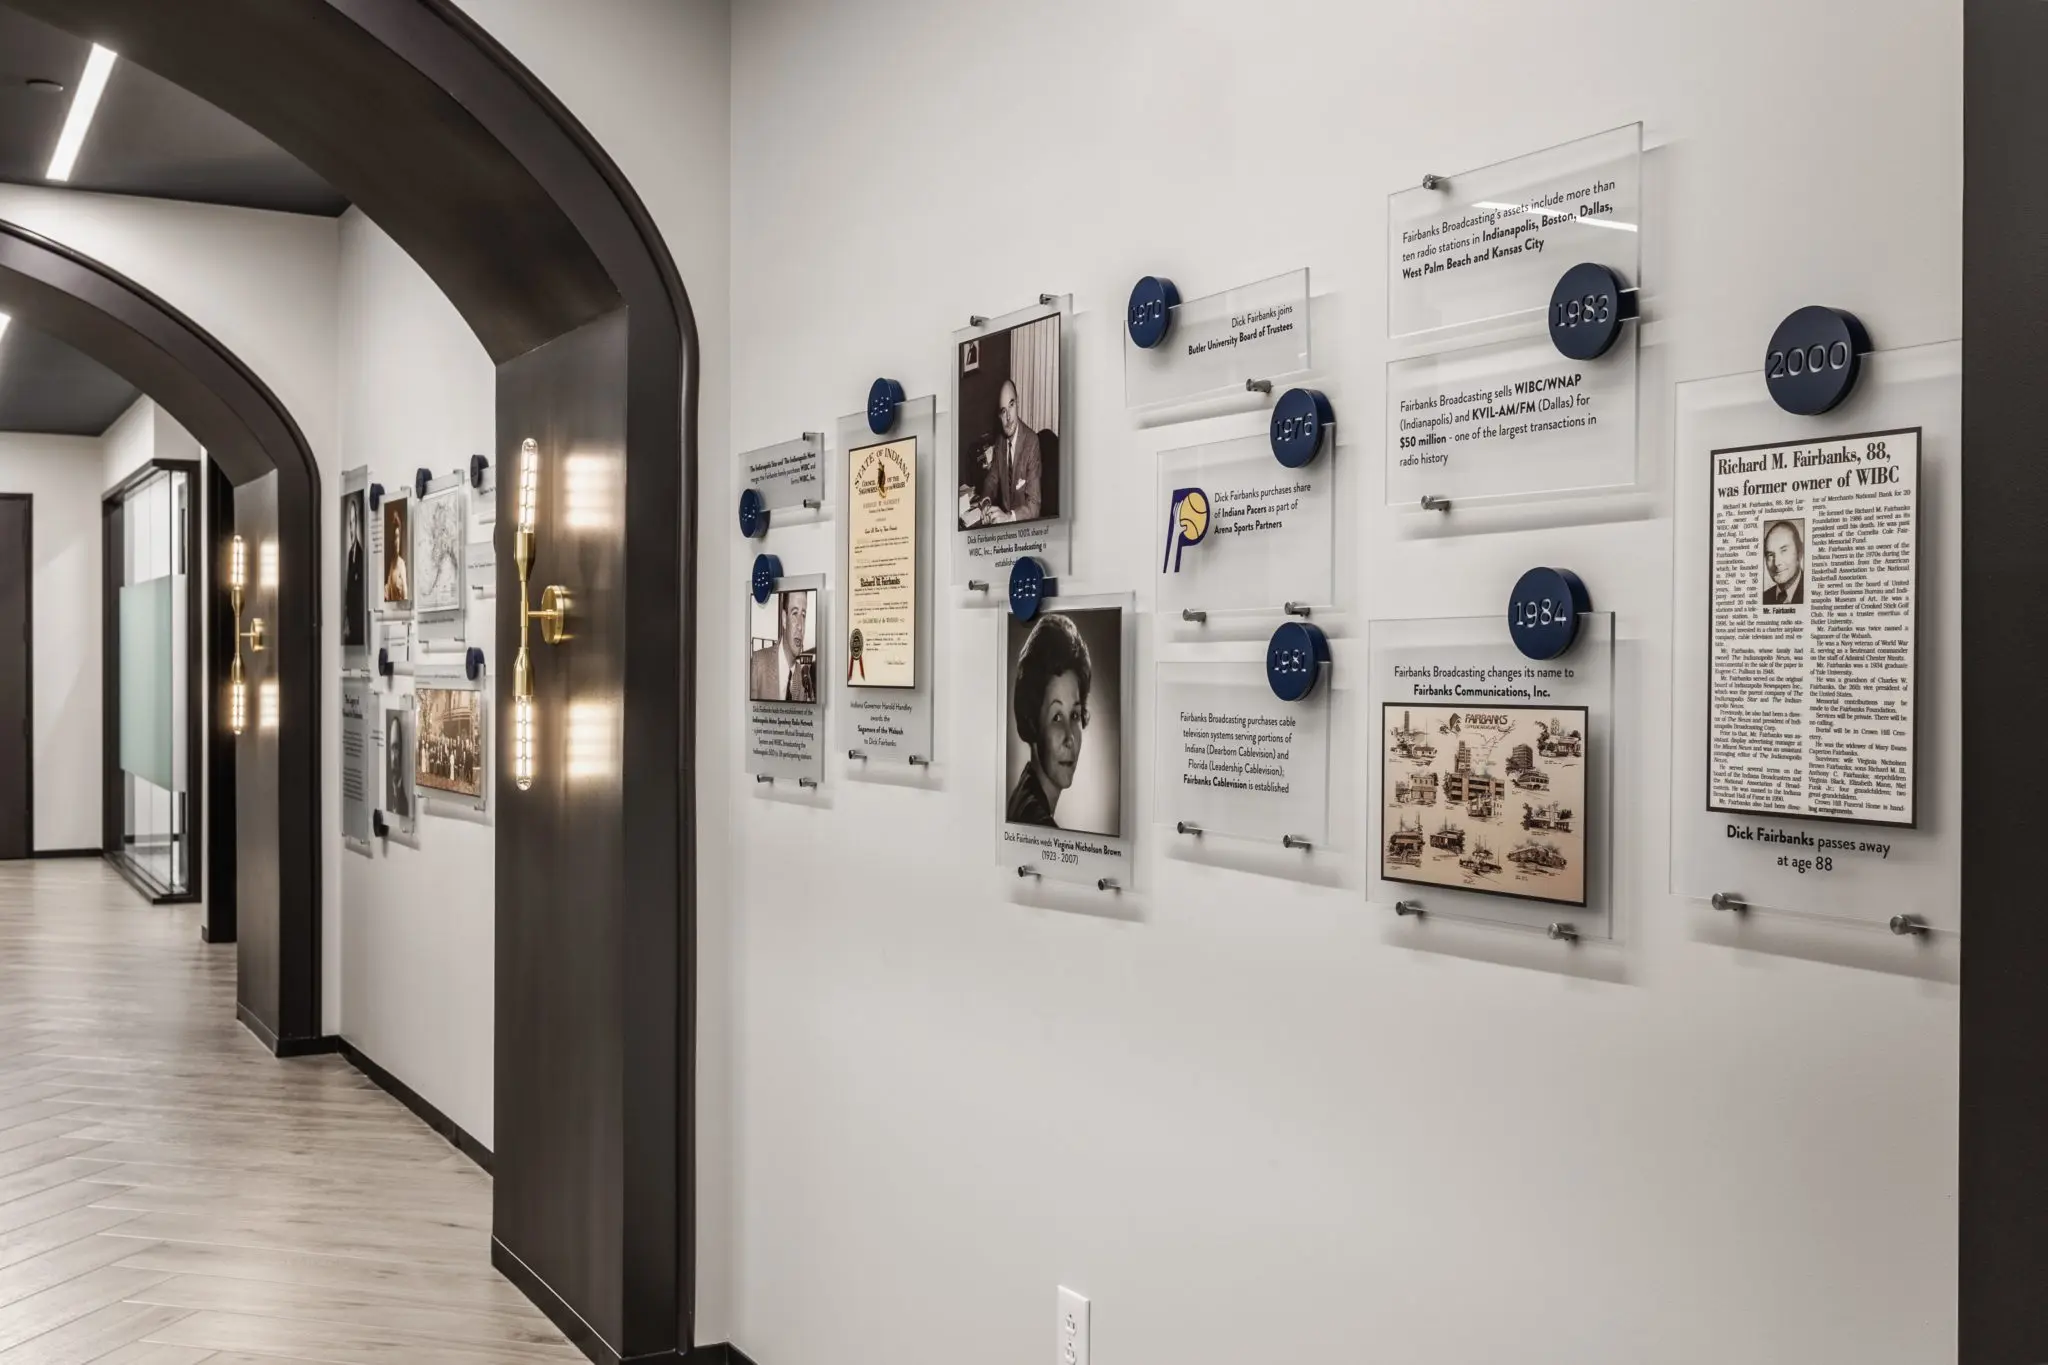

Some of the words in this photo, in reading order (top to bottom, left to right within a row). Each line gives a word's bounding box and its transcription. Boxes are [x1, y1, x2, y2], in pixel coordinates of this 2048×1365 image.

[1402, 225, 1440, 244] Fairbanks
[1442, 208, 1502, 233] Broadcasting's
[1504, 203, 1529, 218] assets
[1531, 189, 1563, 209] include
[1566, 186, 1590, 199] more
[1593, 179, 1615, 192] than
[1402, 251, 1415, 262] ten
[1417, 244, 1436, 259] radio
[1438, 237, 1470, 254] stations
[1472, 234, 1480, 244] in
[1482, 221, 1539, 242] Indianapolis,
[1542, 212, 1576, 227] Boston,
[1580, 202, 1612, 218] Dallas,
[1402, 266, 1422, 280] West
[1424, 262, 1444, 275] Palm
[1447, 256, 1472, 270] Beach
[1474, 249, 1489, 264] and
[1492, 244, 1522, 258] Kansas
[1524, 238, 1544, 252] City
[1131, 299, 1162, 325] 1970
[1232, 316, 1246, 328] Dick
[1248, 310, 1276, 324] Fairbanks
[1278, 305, 1292, 319] joins
[1554, 294, 1610, 328] 1983
[1188, 343, 1206, 355] Butler
[1208, 336, 1238, 350] University
[1239, 329, 1257, 342] Board
[1259, 327, 1265, 336] of
[1267, 322, 1293, 335] Trustees
[1768, 341, 1847, 379] 2000
[1400, 396, 1438, 412] Fairbanks
[1440, 388, 1492, 407] Broadcasting
[1494, 386, 1512, 399] sells
[1515, 373, 1582, 394] WIBC/WNAP
[1400, 413, 1452, 431] (Indianapolis)
[1454, 410, 1470, 422] and
[1472, 400, 1536, 421] KVIL-AM/FM
[1538, 398, 1574, 414] (Dallas)
[1576, 396, 1590, 406] for
[1275, 413, 1312, 442] 1976
[1400, 436, 1416, 448] $50
[1418, 434, 1446, 446] million
[1454, 431, 1470, 442] one
[1472, 428, 1481, 440] of
[1483, 426, 1496, 438] the
[1498, 424, 1527, 439] largest
[1530, 416, 1586, 432] transactions
[1588, 414, 1596, 425] in
[1400, 454, 1419, 466] radio
[1421, 452, 1448, 466] history
[1718, 454, 1767, 475] Richard
[1772, 452, 1788, 469] M.
[1793, 445, 1862, 467] Fairbanks,
[1866, 441, 1891, 462] 88,
[1215, 492, 1229, 503] Dick
[1230, 489, 1259, 501] Fairbanks
[1261, 487, 1292, 500] purchases
[1293, 482, 1311, 493] share
[1718, 484, 1739, 498] was
[1743, 480, 1787, 496] former
[1792, 476, 1832, 491] owner
[1837, 470, 1852, 487] of
[1856, 466, 1899, 485] WIBC
[1214, 508, 1221, 519] of
[1222, 506, 1244, 517] Indiana
[1247, 505, 1266, 514] Pacers
[1276, 503, 1289, 515] part
[1291, 501, 1298, 510] of
[968, 536, 976, 544] Dick
[978, 534, 996, 543] Fairbanks
[997, 532, 1017, 542] purchases
[1043, 526, 1048, 534] of
[1214, 524, 1232, 534] Arena
[1234, 522, 1253, 536] Sports
[1255, 520, 1282, 530] Partners
[993, 545, 1013, 554] Fairbanks
[1014, 541, 1042, 553] Broadcasting
[995, 557, 1017, 567] establishe
[1516, 599, 1567, 628] 1984
[1274, 650, 1307, 674] 1981
[1395, 666, 1430, 678] Fairbanks
[1433, 666, 1485, 681] Broadcasting
[1487, 667, 1522, 681] changes
[1524, 666, 1534, 677] its
[1537, 668, 1562, 678] name
[1564, 668, 1574, 678] to
[1414, 685, 1452, 696] Fairbanks
[1454, 685, 1530, 699] Communications,
[1534, 686, 1550, 698] Inc.
[1181, 712, 1207, 722] Fairbanks
[1209, 714, 1246, 728] Broadcasting
[1248, 716, 1278, 728] purchases
[1279, 717, 1296, 727] cable
[1465, 713, 1508, 724] FAIRBANKS
[1183, 729, 1209, 738] television
[1211, 732, 1234, 744] systems
[1235, 732, 1256, 744] serving
[1258, 733, 1284, 744] portions
[1285, 733, 1292, 743] of
[1185, 744, 1205, 754] Indiana
[1206, 744, 1237, 757] (Dearborn
[1238, 746, 1276, 760] Cablevision)
[1277, 750, 1289, 760] and
[1188, 759, 1207, 770] Florida
[1209, 762, 1243, 774] (Leadership
[1184, 774, 1211, 786] Fairbanks
[1213, 777, 1247, 789] Cablevision
[1249, 780, 1253, 790] is
[1255, 782, 1289, 793] established
[1005, 832, 1015, 841] Dick
[1017, 833, 1039, 845] Fairbanks
[1054, 839, 1074, 852] Virginia
[1075, 842, 1102, 854] Nicholson
[1104, 846, 1121, 857] Brown
[1727, 825, 1753, 840] Dick
[1757, 828, 1814, 846] Fairbanks
[1818, 838, 1855, 851] passes
[1859, 842, 1890, 858] away
[1042, 850, 1056, 861] (1923
[1061, 854, 1078, 865] 2007)
[1778, 856, 1788, 866] at
[1792, 859, 1812, 873] age
[1816, 857, 1832, 871] 88
